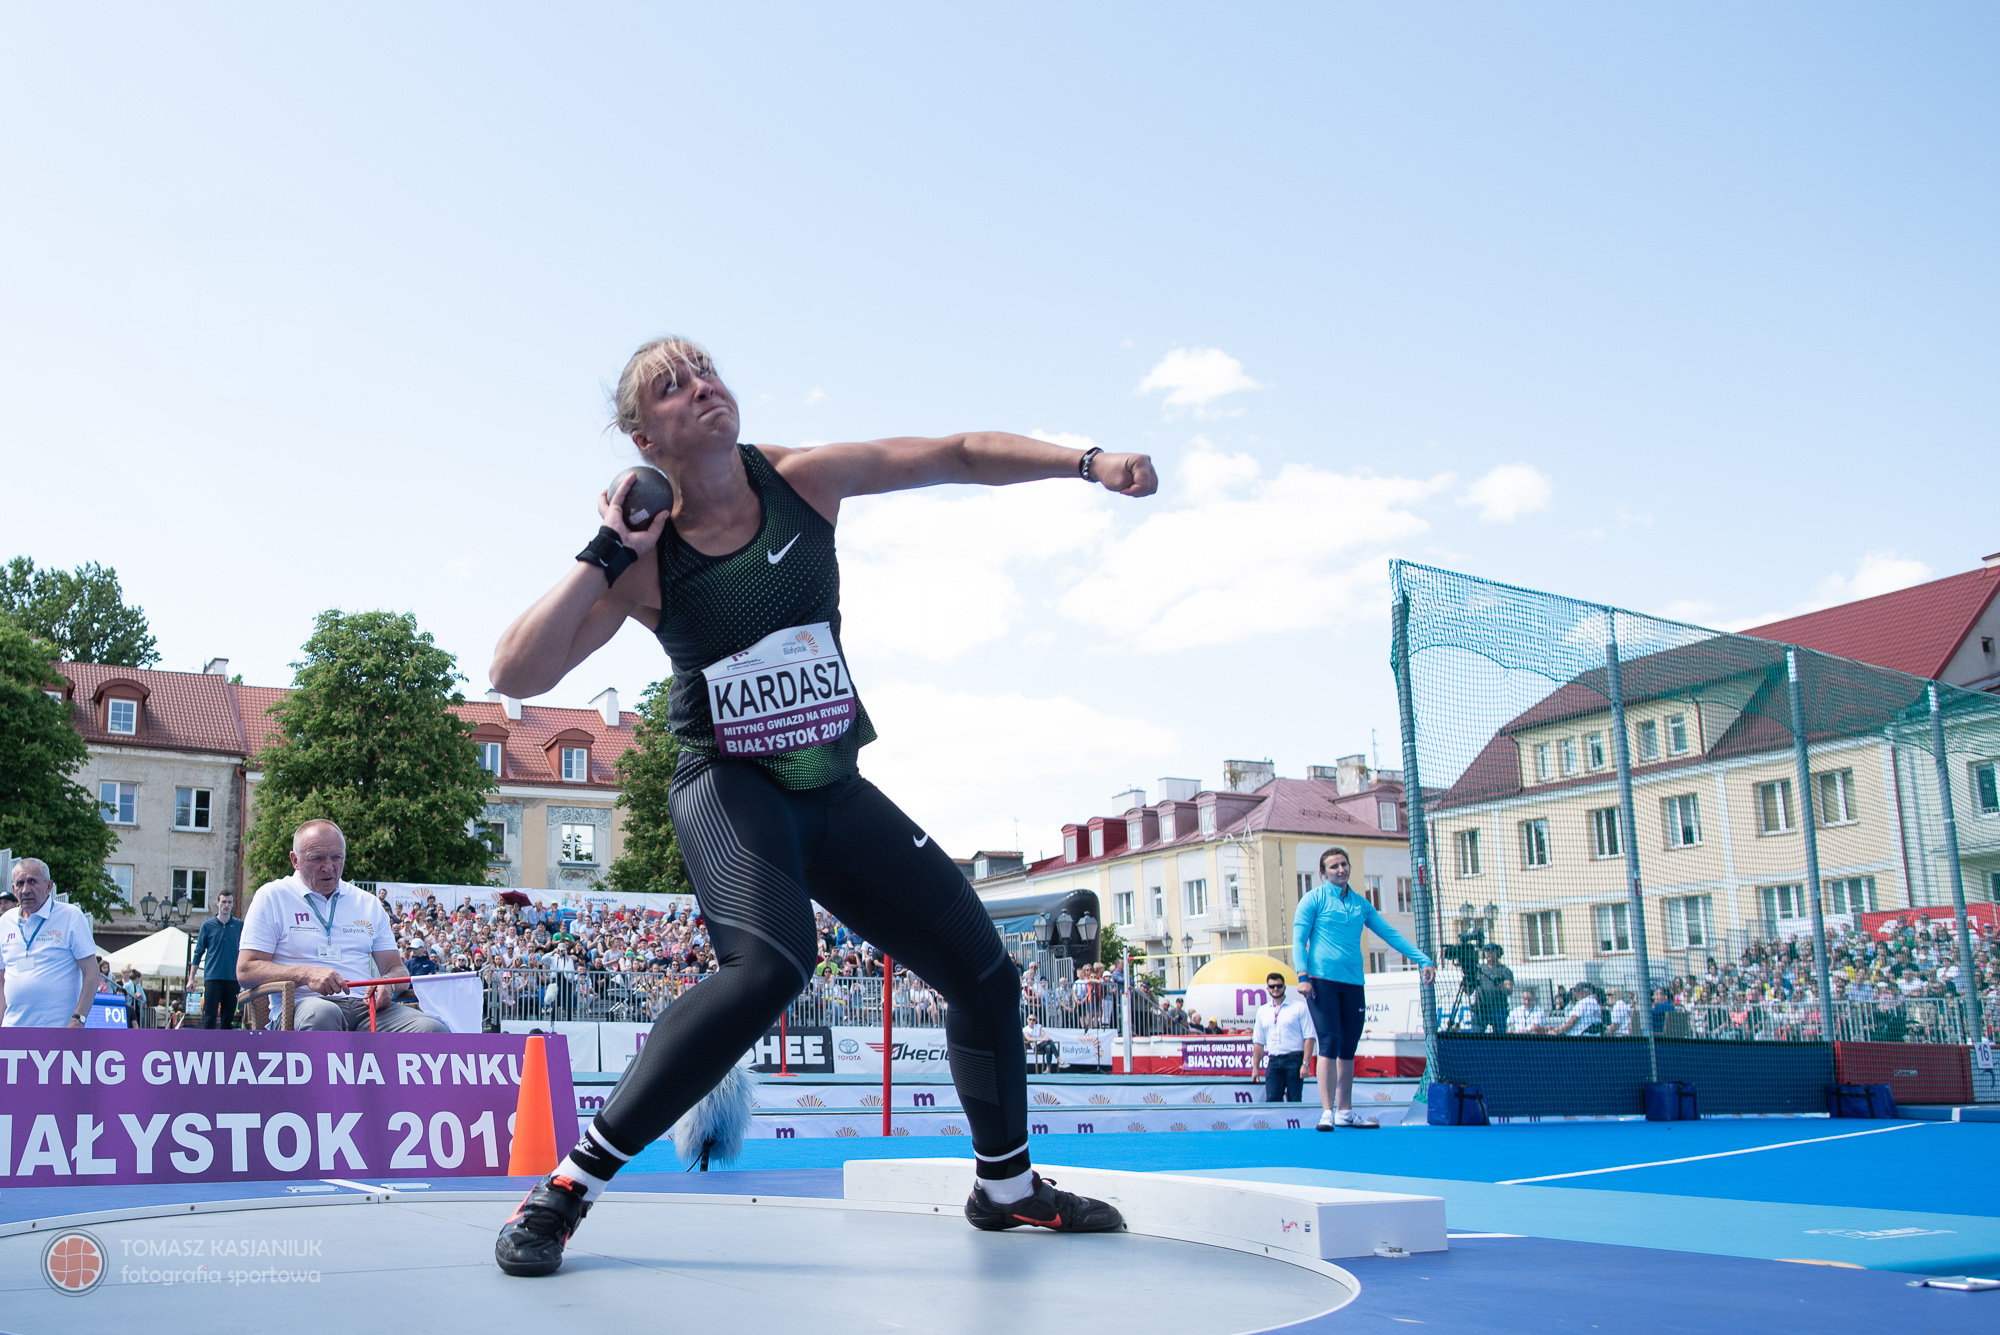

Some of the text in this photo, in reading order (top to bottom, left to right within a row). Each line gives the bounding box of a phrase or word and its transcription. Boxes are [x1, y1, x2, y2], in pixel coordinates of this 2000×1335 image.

[714, 661, 849, 720] KARDASZ
[724, 704, 849, 736] MITYNG GWIAZD NA RYNKU
[726, 719, 850, 753] BIAŁYSTOK 2018
[105, 1007, 126, 1023] POL
[1062, 1046, 1091, 1056] Białystok
[1187, 1044, 1211, 1053] MITYNG
[1211, 1044, 1236, 1052] GWIAZD
[1236, 1044, 1246, 1052] NA
[1978, 1044, 1990, 1061] 16
[141, 1050, 313, 1085] GWIAZD
[327, 1052, 386, 1085] NA
[1187, 1055, 1243, 1069] BIAŁYSTOK
